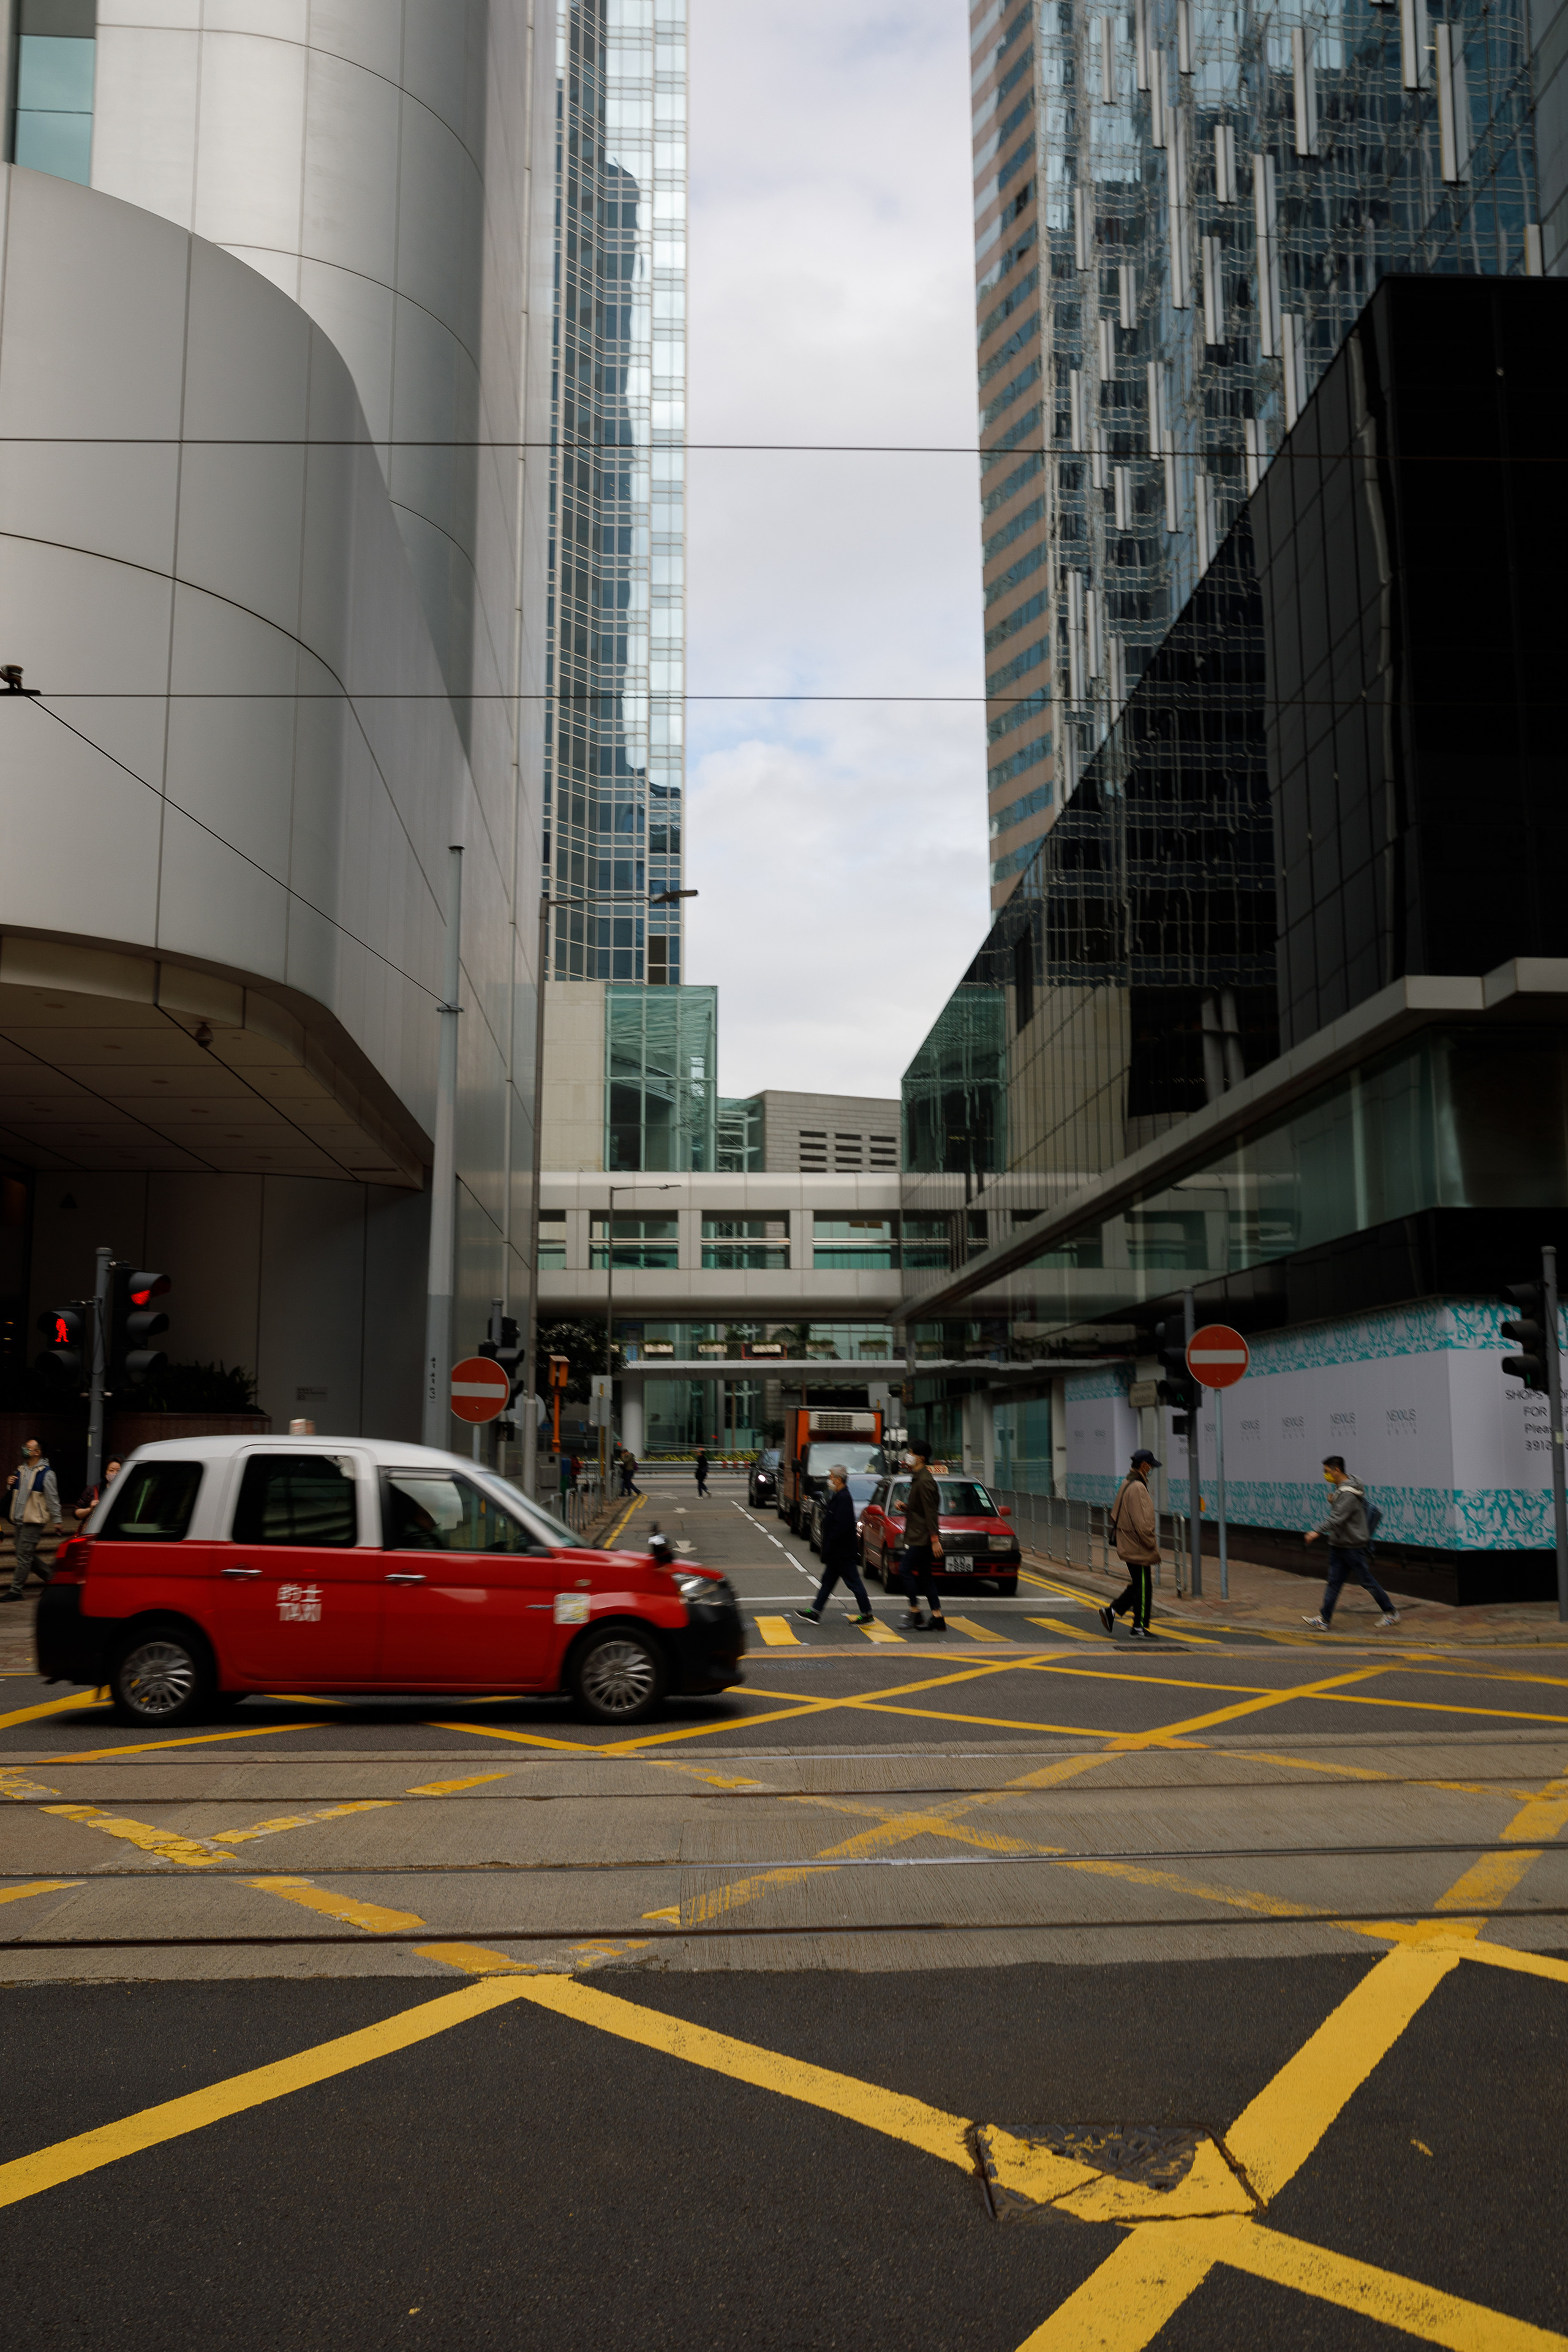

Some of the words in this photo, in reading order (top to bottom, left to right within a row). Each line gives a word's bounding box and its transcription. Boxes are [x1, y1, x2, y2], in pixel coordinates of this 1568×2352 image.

[1504, 1388, 1544, 1400] SHOPS
[1523, 1406, 1547, 1417] FOR
[277, 1583, 324, 1602] 的士
[276, 1602, 322, 1622] TAXI
